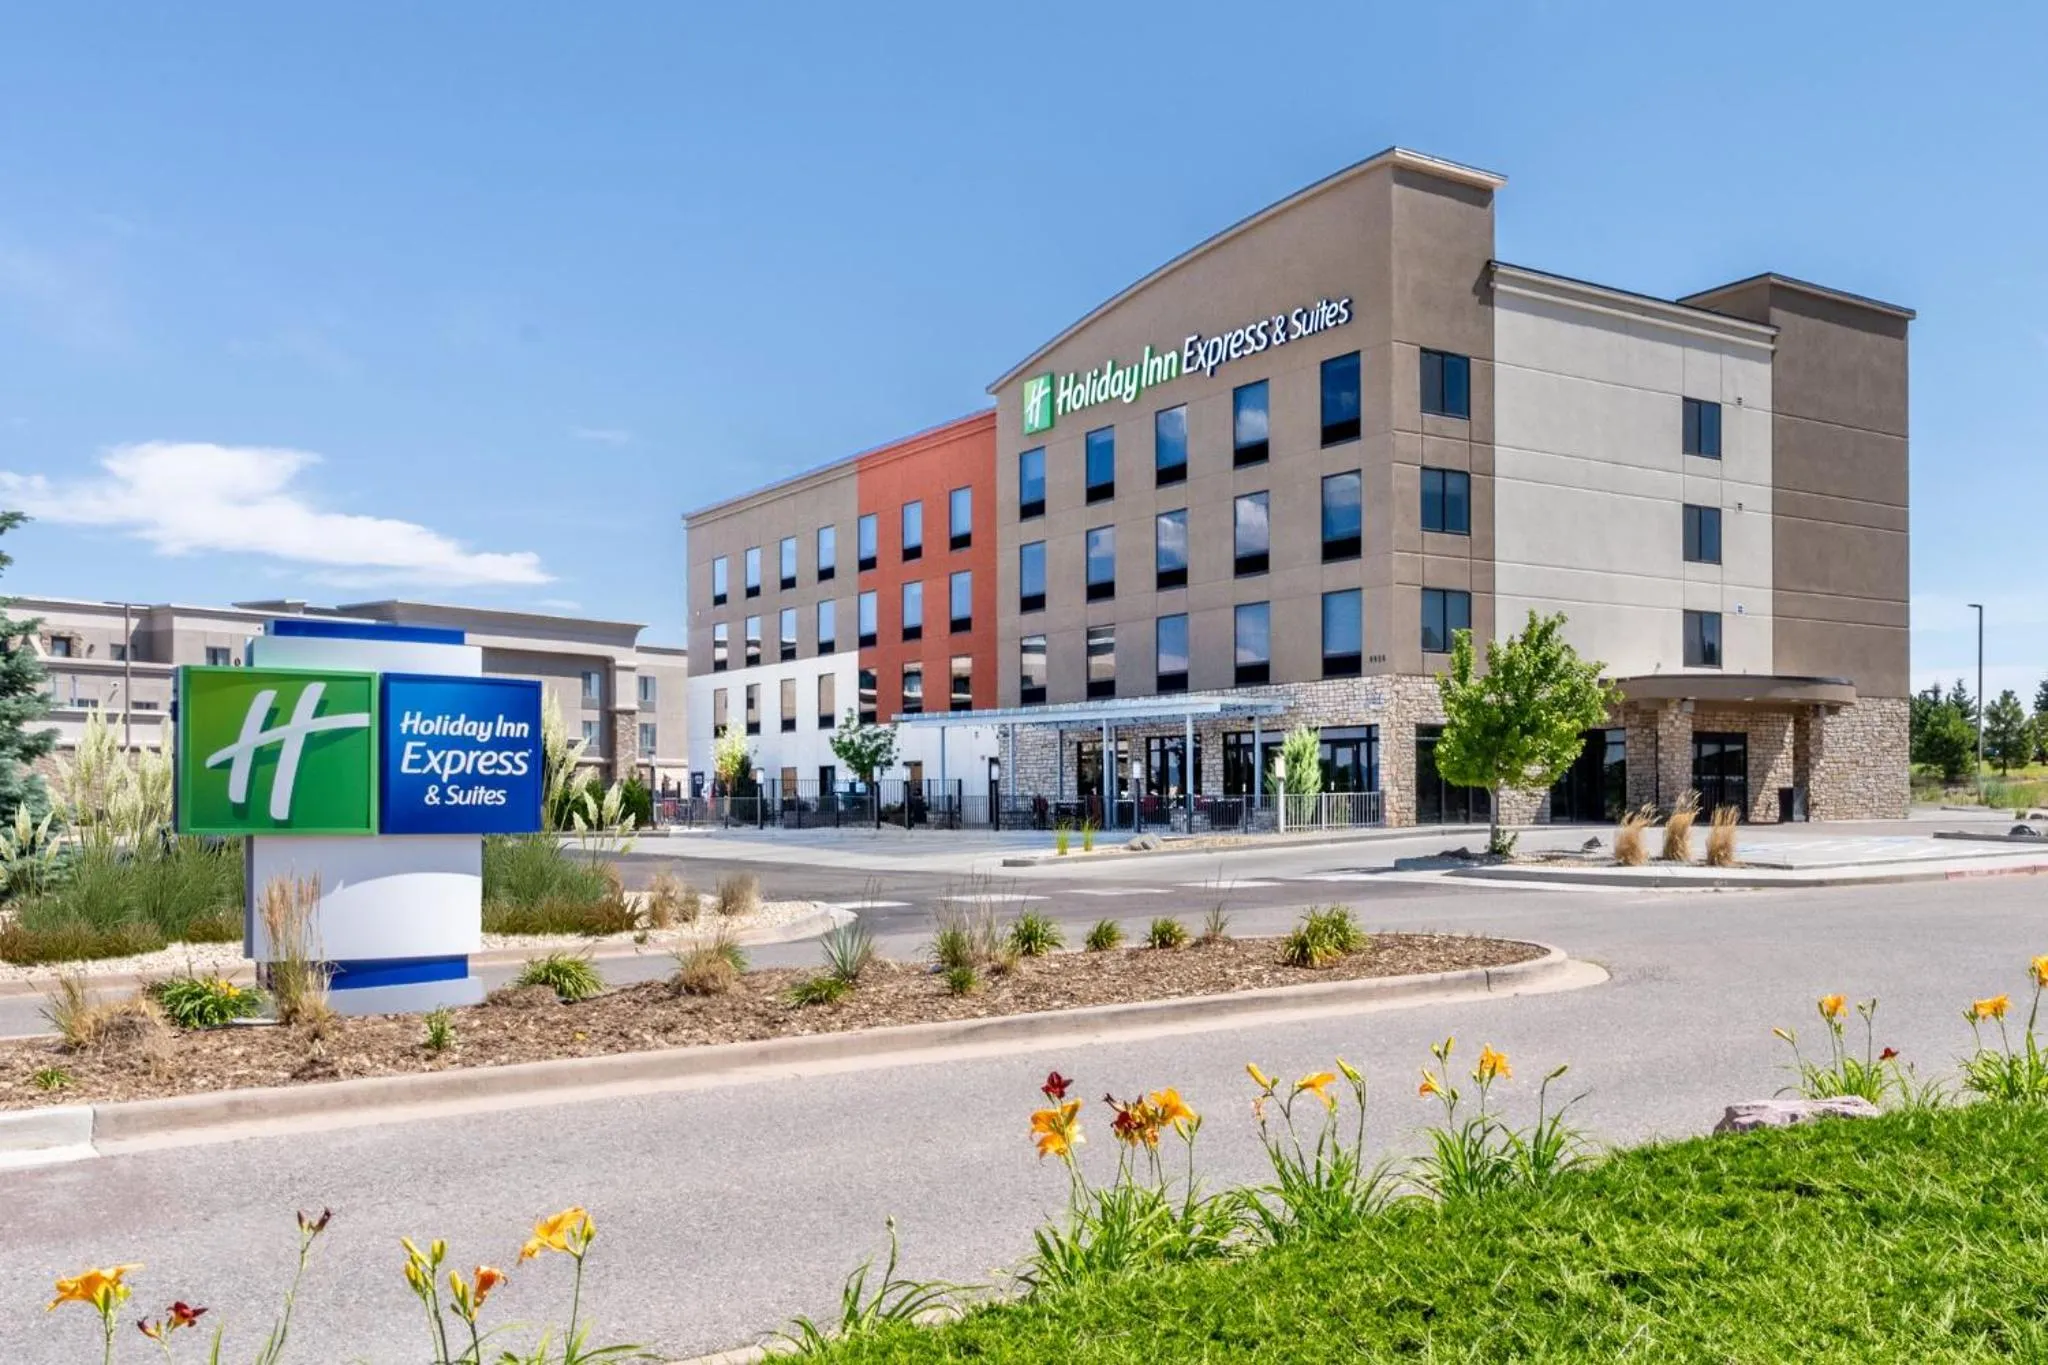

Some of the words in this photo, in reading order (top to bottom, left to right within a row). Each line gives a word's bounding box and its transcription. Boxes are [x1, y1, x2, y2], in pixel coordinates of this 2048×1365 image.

[1056, 360, 1140, 416] Holiday
[1140, 345, 1179, 389] Inn
[1181, 319, 1270, 377] Express
[1271, 314, 1288, 345] &
[1289, 298, 1352, 341] Suites
[399, 710, 494, 743] Holiday
[494, 714, 530, 738] Inn
[400, 741, 529, 783] Express
[424, 784, 441, 805] &
[444, 784, 508, 806] Suites
